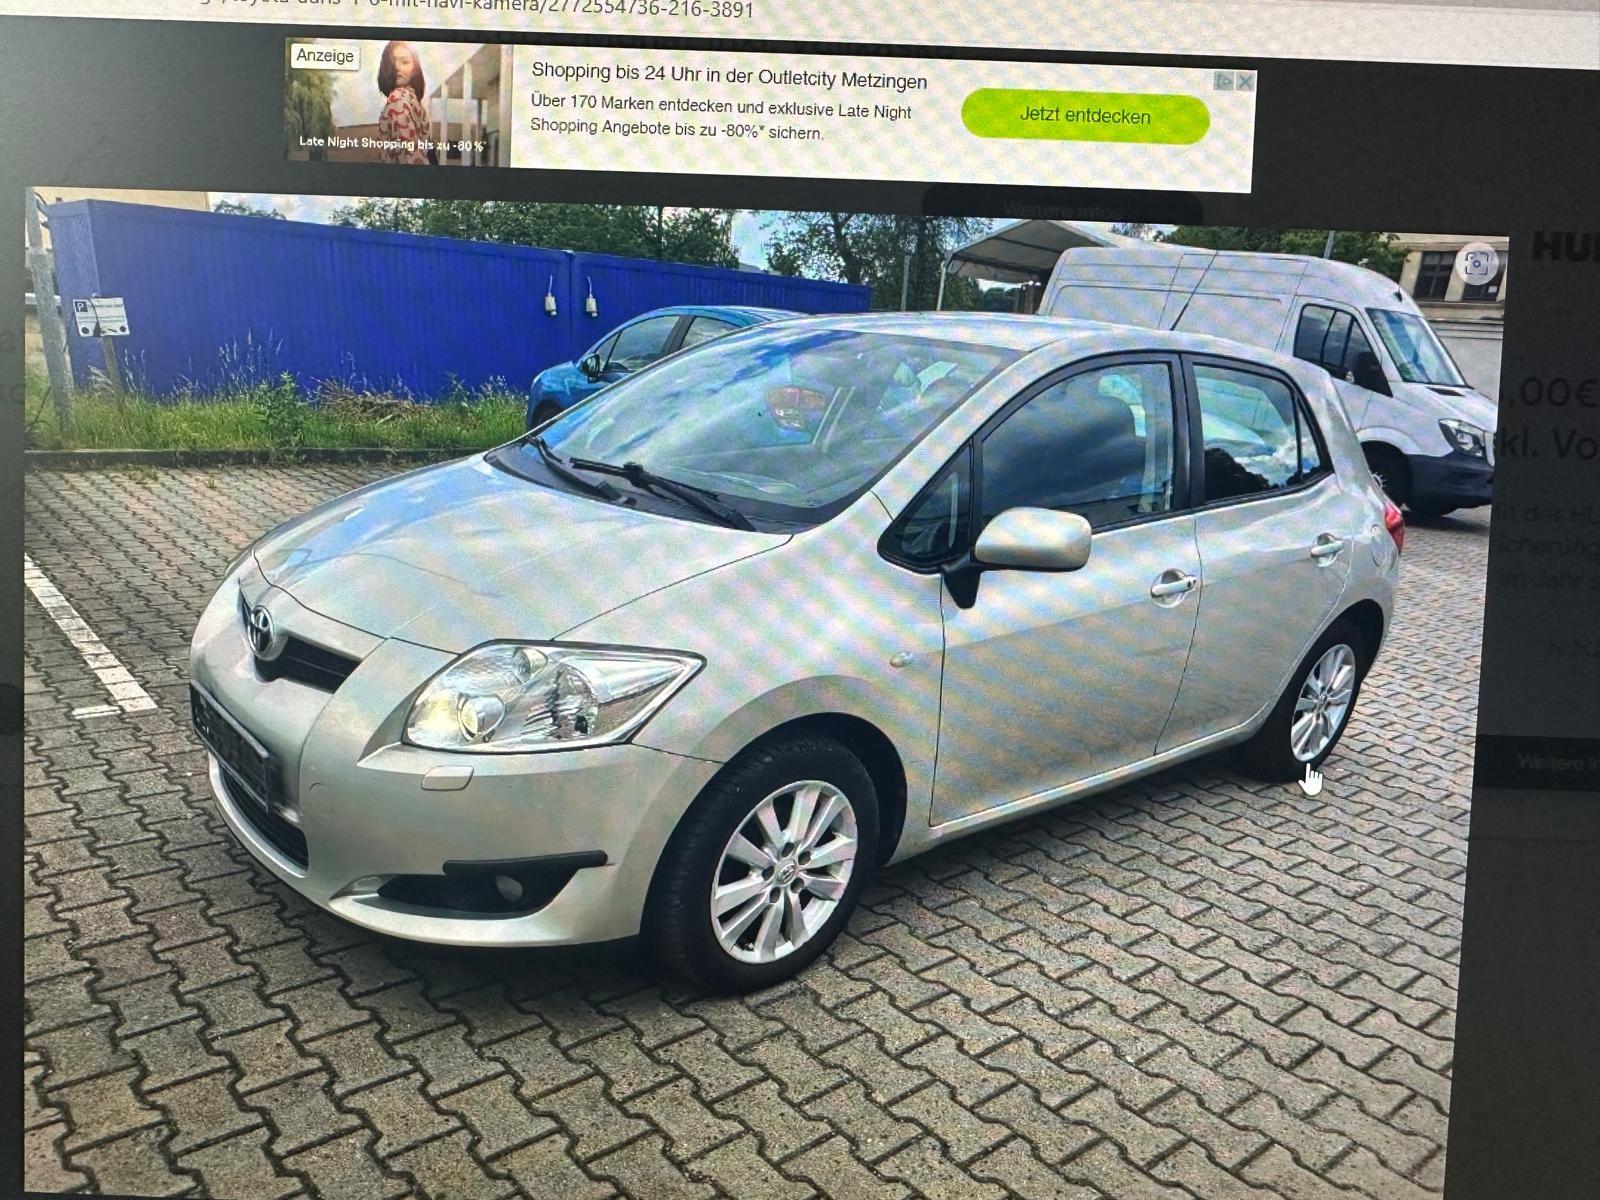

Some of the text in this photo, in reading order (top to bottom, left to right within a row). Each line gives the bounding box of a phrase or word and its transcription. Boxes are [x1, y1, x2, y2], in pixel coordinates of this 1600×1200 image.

[296, 47, 354, 66] Anzeige
[532, 62, 927, 93] Shopping bis 24 Uhr in der Outletcity Metzingen
[531, 91, 912, 121] Über 170 Marken entdecken und exklusive Late Night
[1020, 105, 1151, 124] Jetzt entdecken
[531, 117, 597, 135] Shopping
[602, 119, 671, 137] Angebote
[675, 121, 696, 136] bis
[699, 125, 717, 137] zu
[769, 125, 824, 141] sichern.
[299, 135, 325, 147] Late
[328, 136, 359, 149] Night
[361, 137, 415, 152] Shopping
[417, 139, 434, 151] bis
[436, 142, 450, 152] zu
[1500, 376, 1598, 408] ,00€
